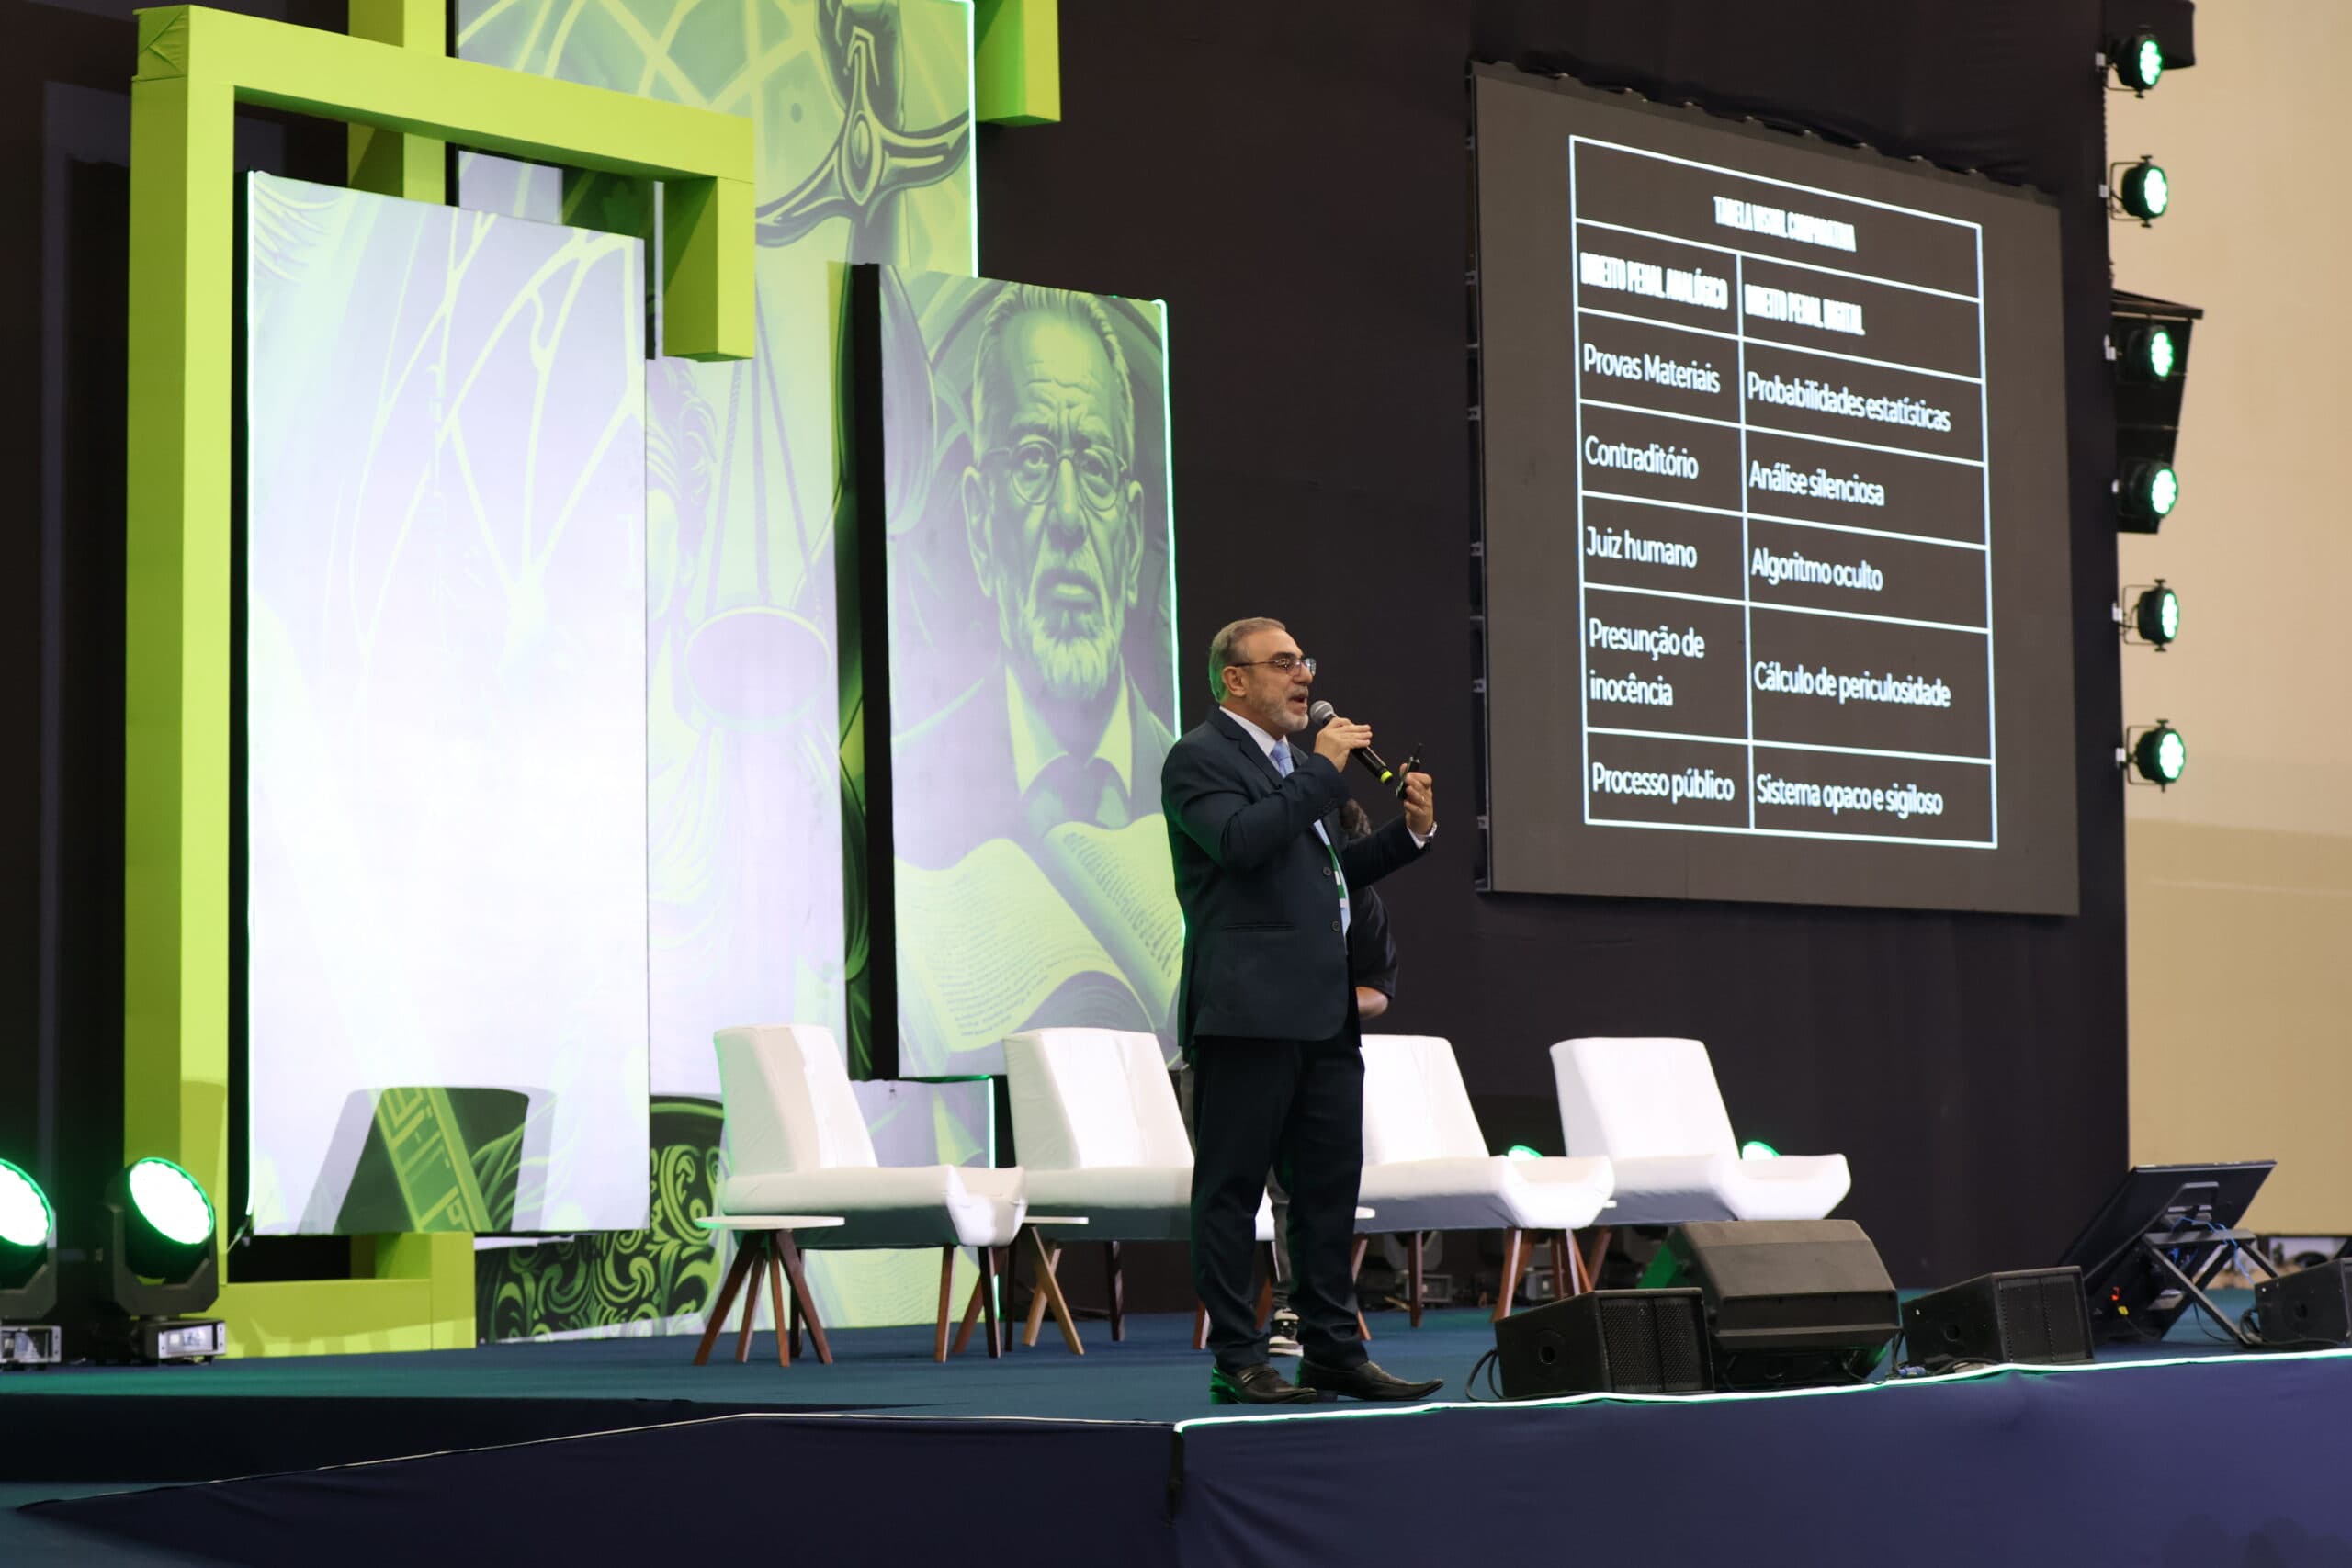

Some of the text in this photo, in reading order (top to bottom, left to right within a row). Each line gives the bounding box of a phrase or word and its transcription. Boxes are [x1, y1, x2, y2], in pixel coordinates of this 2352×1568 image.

[1579, 251, 1626, 291] DIREITO
[1627, 260, 1666, 299] PENAL
[1744, 283, 1787, 321] DIREITO
[1787, 291, 1824, 329] PENAL
[1583, 343, 1721, 394] Provas Materiais
[1747, 370, 1951, 433] Probabilidades estatísticas
[1584, 434, 1699, 479] Contraditório
[1748, 459, 1885, 507] Análise silenciosa
[1586, 525, 1698, 569] Juiz humano
[1750, 547, 1883, 592] Algoritmo oculto
[1589, 617, 1705, 662] Presunção de
[1589, 669, 1674, 706] inocência
[1753, 660, 1951, 708] Cálculo de periculosidade
[1591, 761, 1736, 805] Processo público
[1756, 773, 1944, 820] Sistema opaco e sigiloso
